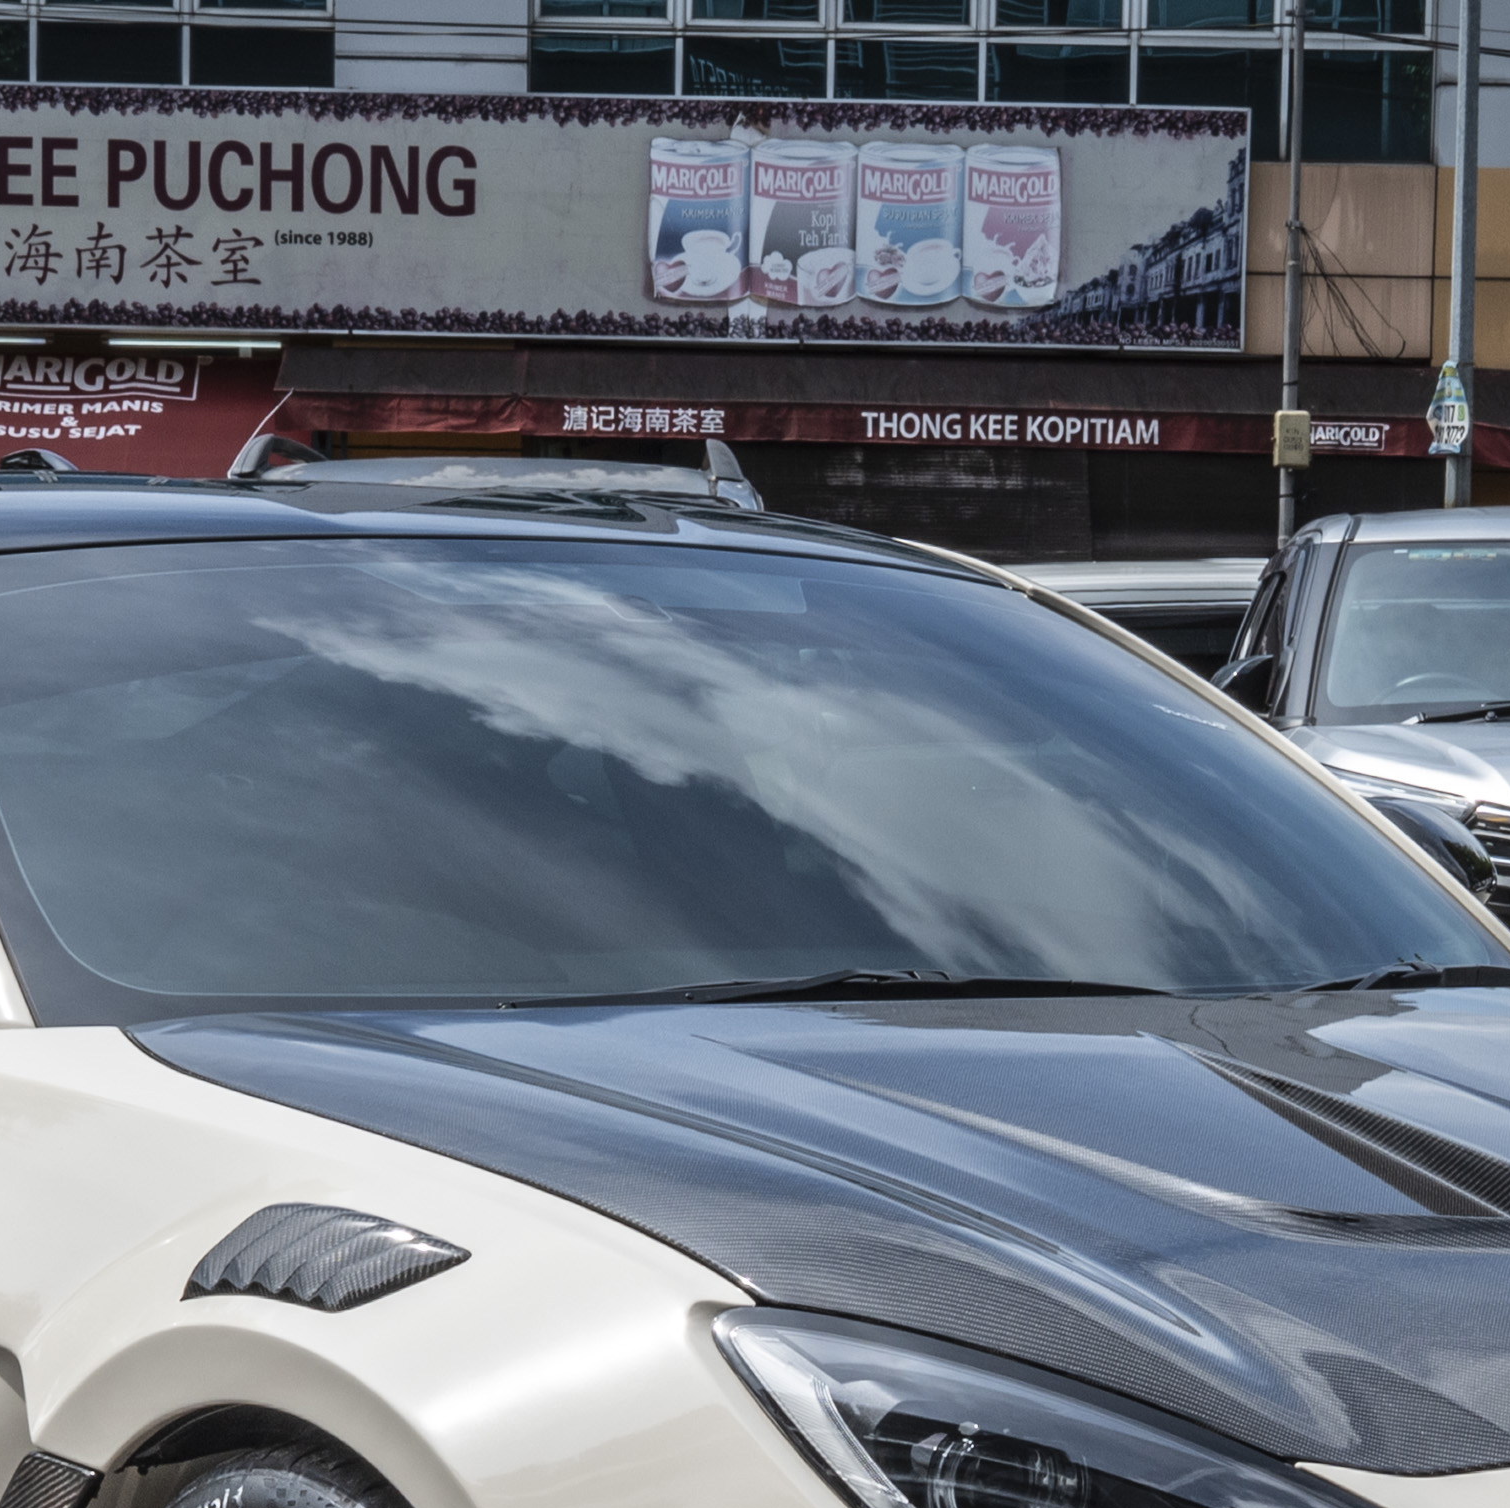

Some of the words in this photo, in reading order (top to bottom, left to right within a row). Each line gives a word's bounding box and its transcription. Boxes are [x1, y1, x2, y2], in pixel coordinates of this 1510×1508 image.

[106, 139, 477, 218] PUCHONG
[652, 163, 738, 196] MARIGOLD
[758, 165, 846, 198] MARIGOLD
[864, 168, 951, 201] MARIGOLD
[972, 171, 1057, 203] MARIGOLD
[811, 211, 836, 232] Kopi
[273, 230, 322, 249] (since
[326, 230, 373, 249] 1988)
[799, 230, 818, 247] Teh
[81, 399, 163, 414] MANIS
[60, 415, 78, 428] &
[68, 424, 142, 440] SEJAT
[861, 411, 962, 440] THONG
[969, 414, 1019, 441] KEE
[1026, 416, 1159, 446] KOPITIAM
